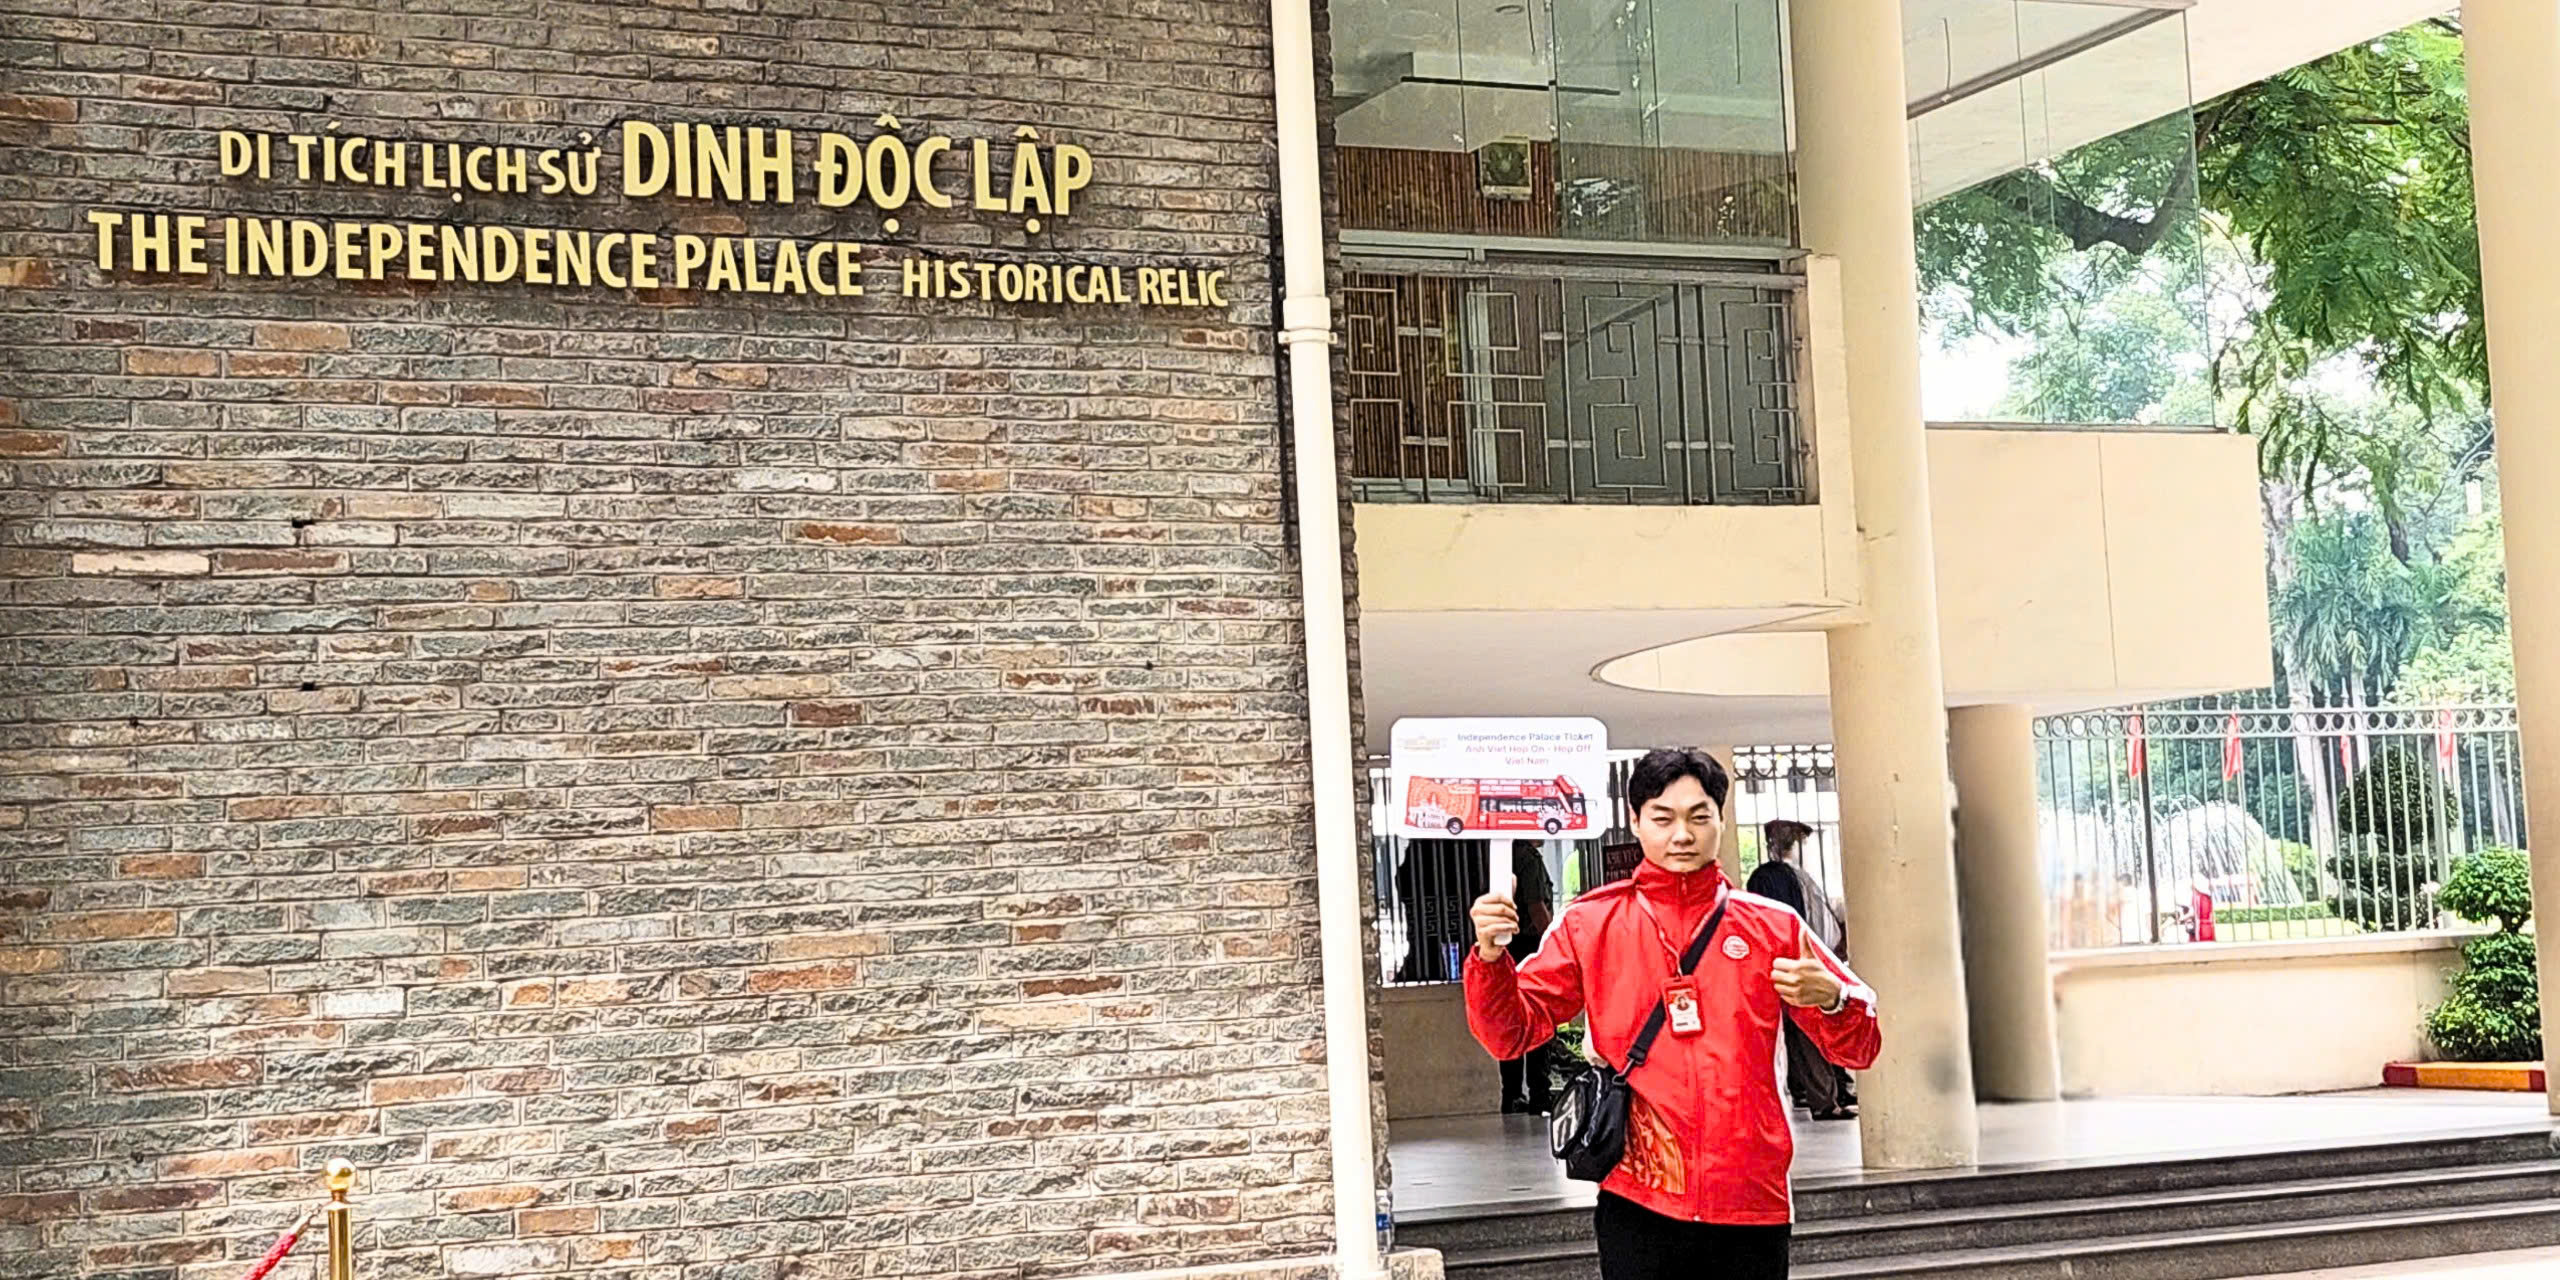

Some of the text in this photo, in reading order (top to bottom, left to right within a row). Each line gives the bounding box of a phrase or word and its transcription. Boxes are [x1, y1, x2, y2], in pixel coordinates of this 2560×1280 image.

[219, 112, 1093, 235] DI TÍCH LỊCH SỬ DINH ĐỘC LẬP
[87, 210, 1230, 307] THE INDEPENDENCE PALACE HISTORICAL RELIC
[1457, 733, 1526, 742] Independence
[1529, 733, 1561, 741] Palace
